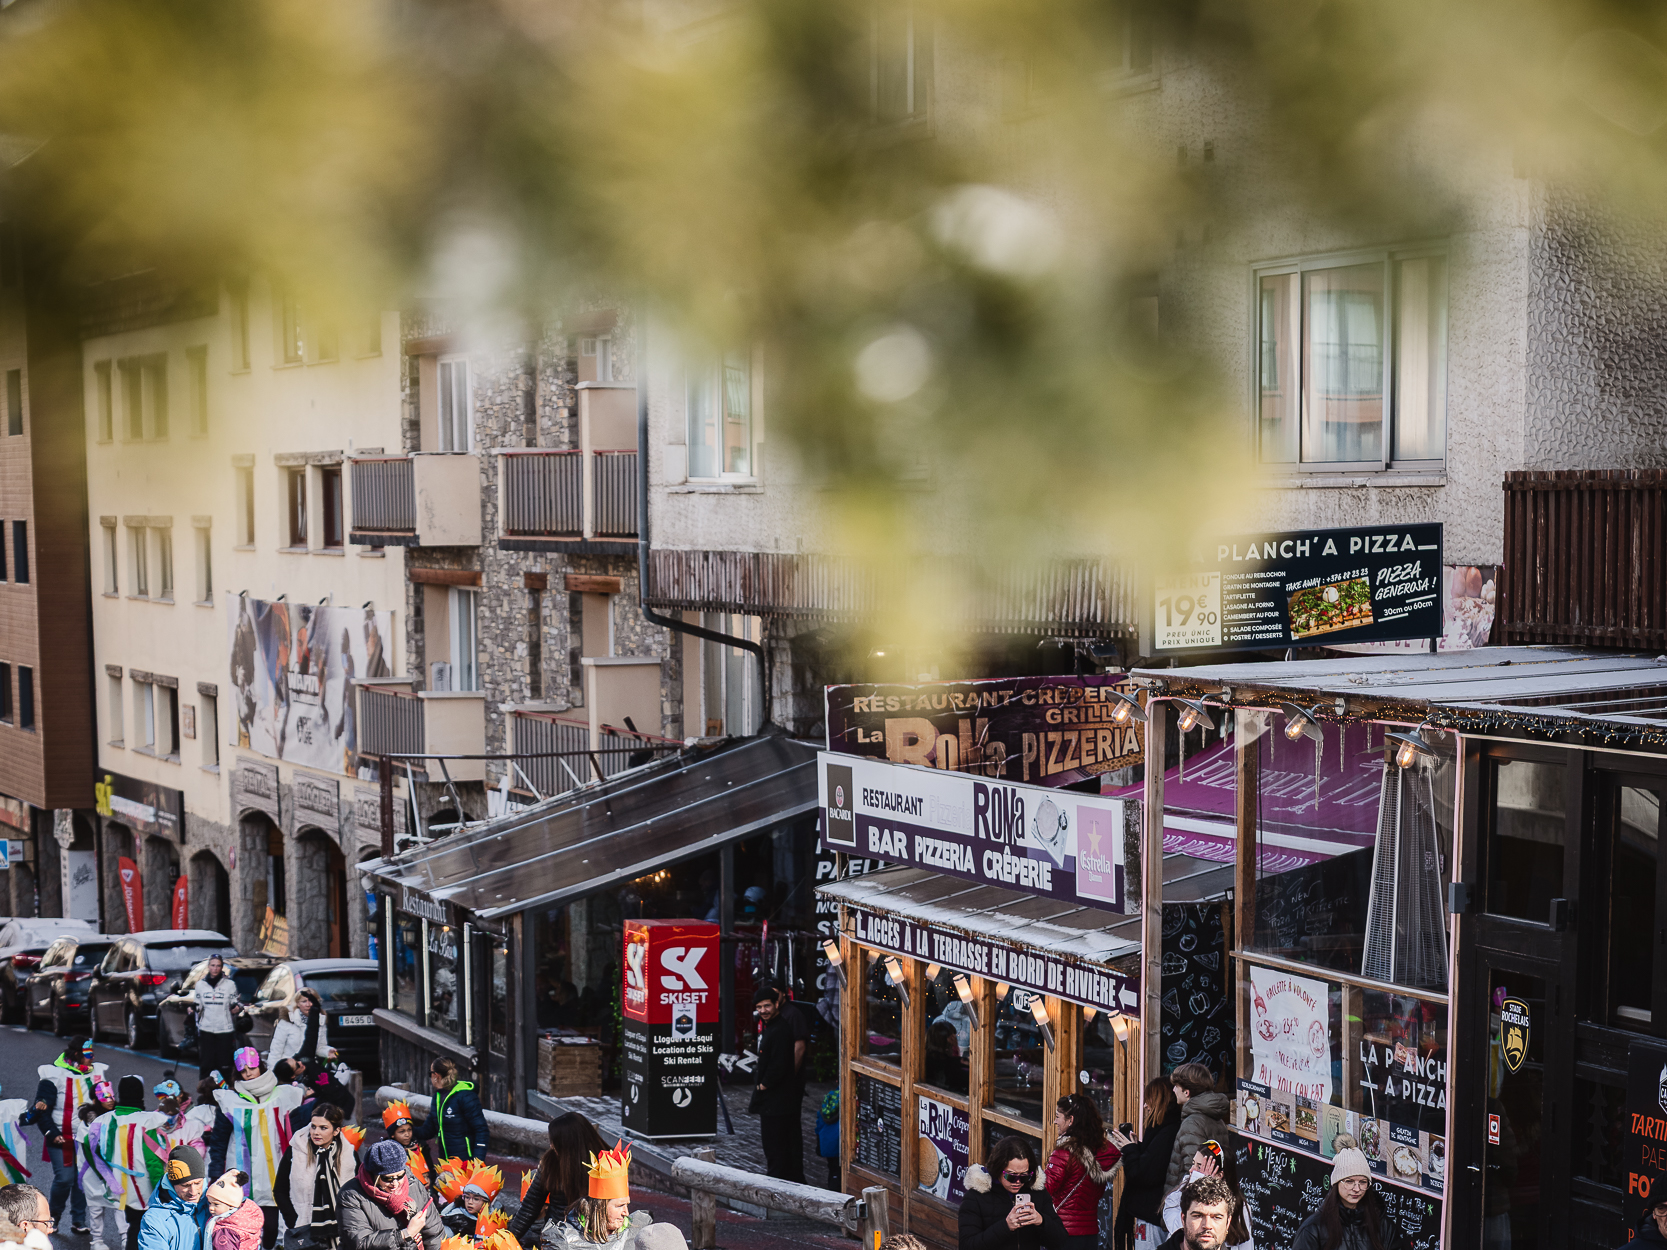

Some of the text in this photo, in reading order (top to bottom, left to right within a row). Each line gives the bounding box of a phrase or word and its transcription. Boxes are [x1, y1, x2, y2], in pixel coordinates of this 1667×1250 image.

[1217, 537, 1338, 562] PLANCH'A
[1350, 533, 1416, 555] PIZZA
[1166, 575, 1210, 589] MENU
[1285, 582, 1302, 592] TAKE
[1302, 577, 1321, 588] AWAY
[1326, 573, 1342, 583] +376
[1351, 569, 1360, 578] 23
[1360, 567, 1369, 576] 23
[1376, 560, 1421, 586] PIZZA
[1251, 581, 1280, 589] MONTAGNE
[1375, 579, 1429, 601] GENEROSA
[1383, 600, 1433, 616] 30cm ou 60cm
[1252, 623, 1282, 631] COMPOSÉE
[1162, 637, 1215, 646] PRIX UNIQUE
[853, 690, 1014, 713] RESTAURANT
[1045, 704, 1117, 725] GRILL
[857, 727, 884, 743] La
[1022, 726, 1140, 782] PIZZERIA
[862, 787, 923, 817] RESTAURANT
[829, 806, 852, 822] BACARDI
[868, 825, 1053, 892] BAR PIZZERIA CRÊPERIE
[1080, 849, 1111, 875] Estrella
[402, 885, 447, 923] Restaurant
[660, 946, 709, 990] SK
[867, 915, 900, 949] ACCÈS
[903, 921, 912, 951] À
[916, 929, 929, 957] LA
[933, 933, 988, 974] TERRASSE
[991, 947, 1007, 977] EN
[1009, 953, 1045, 987] BORD
[1047, 961, 1064, 992] DE
[1066, 967, 1116, 1008] RIVIÈRE
[660, 992, 708, 1005] SKISET
[1265, 979, 1287, 1001] RACLETTE
[1293, 983, 1317, 1012] VOLONTÉ
[1501, 1011, 1529, 1027] ROCHELAIS
[1509, 1003, 1522, 1014] STADE
[652, 1044, 713, 1055] Location de Skis
[663, 1056, 702, 1065] Ski Rental
[1360, 1041, 1379, 1066] LA
[1259, 1063, 1272, 1087] ALL
[1277, 1074, 1292, 1094] YOU
[1295, 1081, 1309, 1098] CAN
[1310, 1083, 1325, 1101] EAT
[1384, 1075, 1447, 1111] A PIZZA
[920, 1099, 928, 1111] La
[920, 1118, 929, 1136] Di
[1264, 1146, 1288, 1171] MENU
